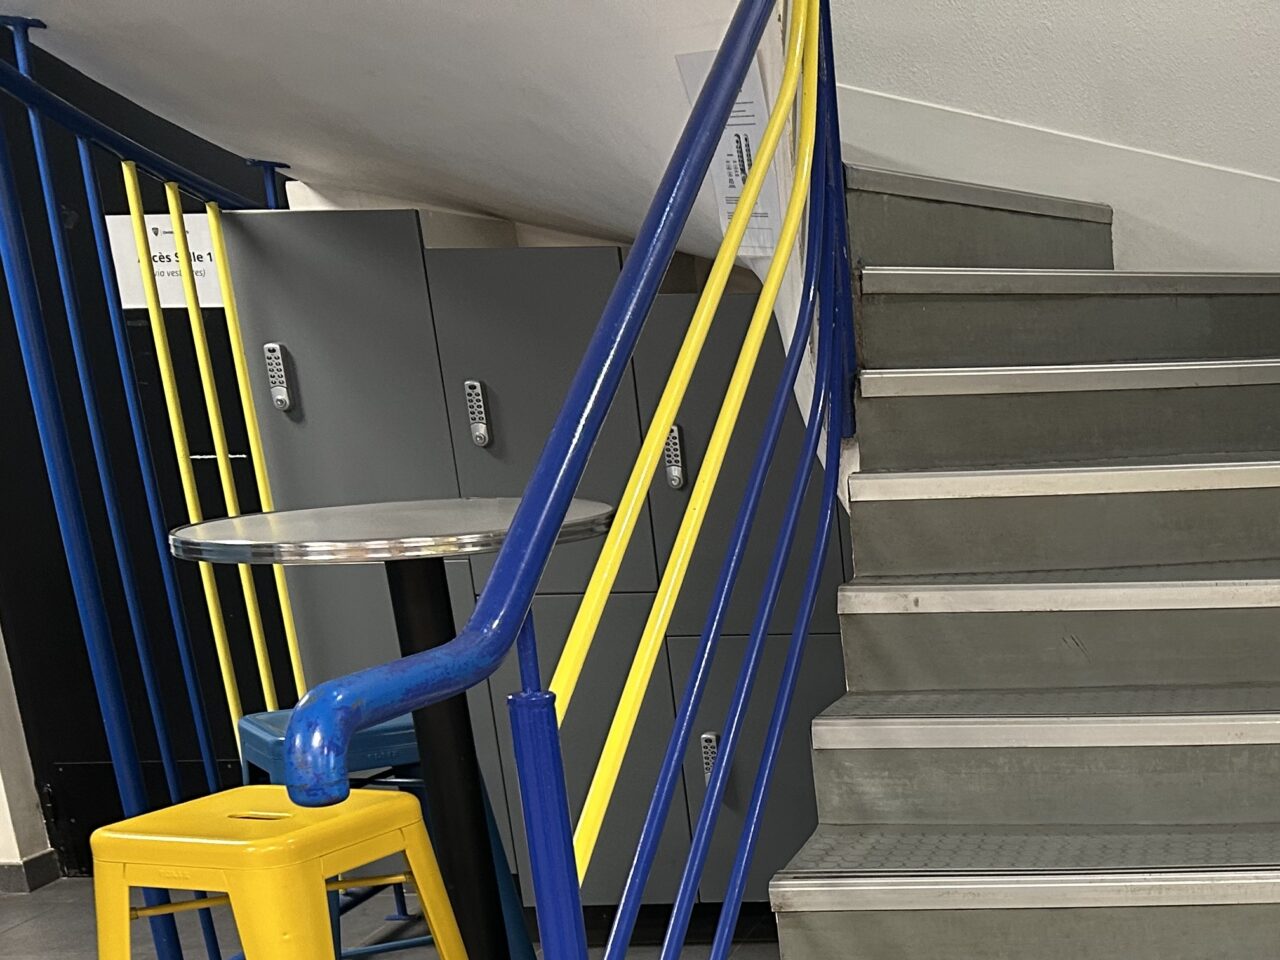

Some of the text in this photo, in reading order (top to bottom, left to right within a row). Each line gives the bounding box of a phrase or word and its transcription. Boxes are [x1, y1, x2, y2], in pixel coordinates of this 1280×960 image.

[137, 251, 213, 263] cès Sle 1
[152, 269, 206, 278] via vestes)
